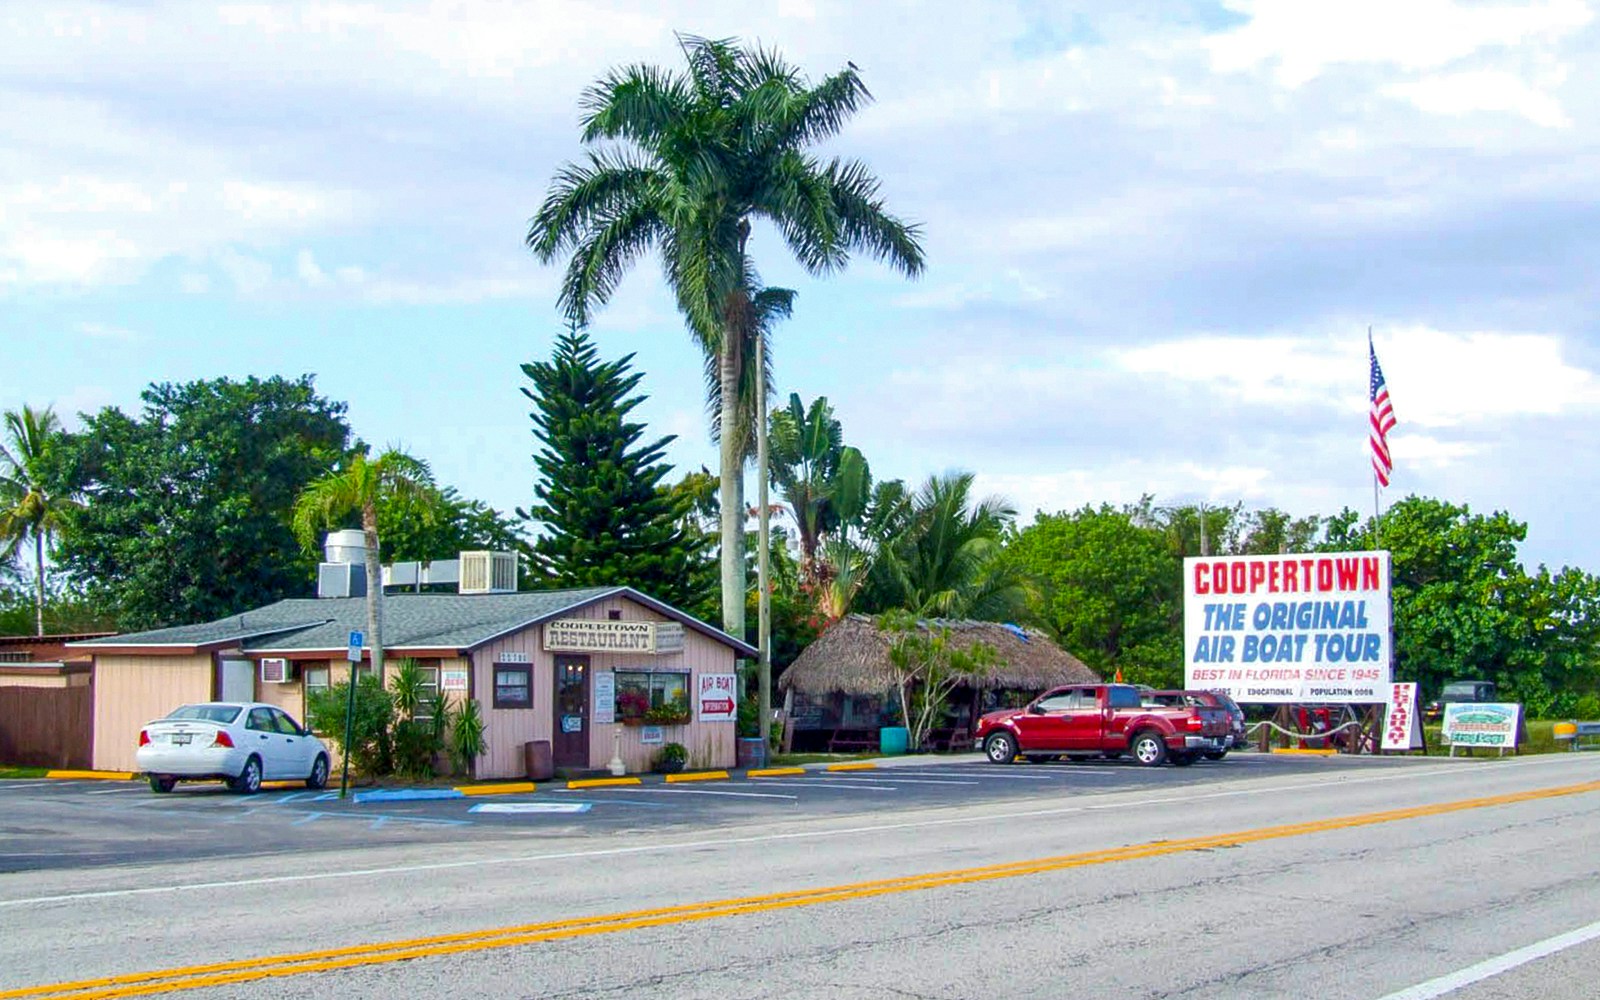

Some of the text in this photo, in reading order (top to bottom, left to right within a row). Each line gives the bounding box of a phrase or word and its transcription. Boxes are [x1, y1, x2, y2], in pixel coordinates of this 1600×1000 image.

[1194, 557, 1380, 594] COOPERTOWN
[1203, 600, 1368, 631] THE ORIGINAL
[551, 622, 648, 632] COOPERTOWN
[549, 631, 649, 649] RESTAURANT
[1193, 633, 1381, 663] AIR BOAT TOUR
[1192, 668, 1380, 681] BEST IN FLORIDA SINCE 1945
[702, 677, 734, 695] AIR BOAT
[1247, 688, 1293, 696] EDUCATIONAL
[1310, 688, 1352, 696] POPULATION
